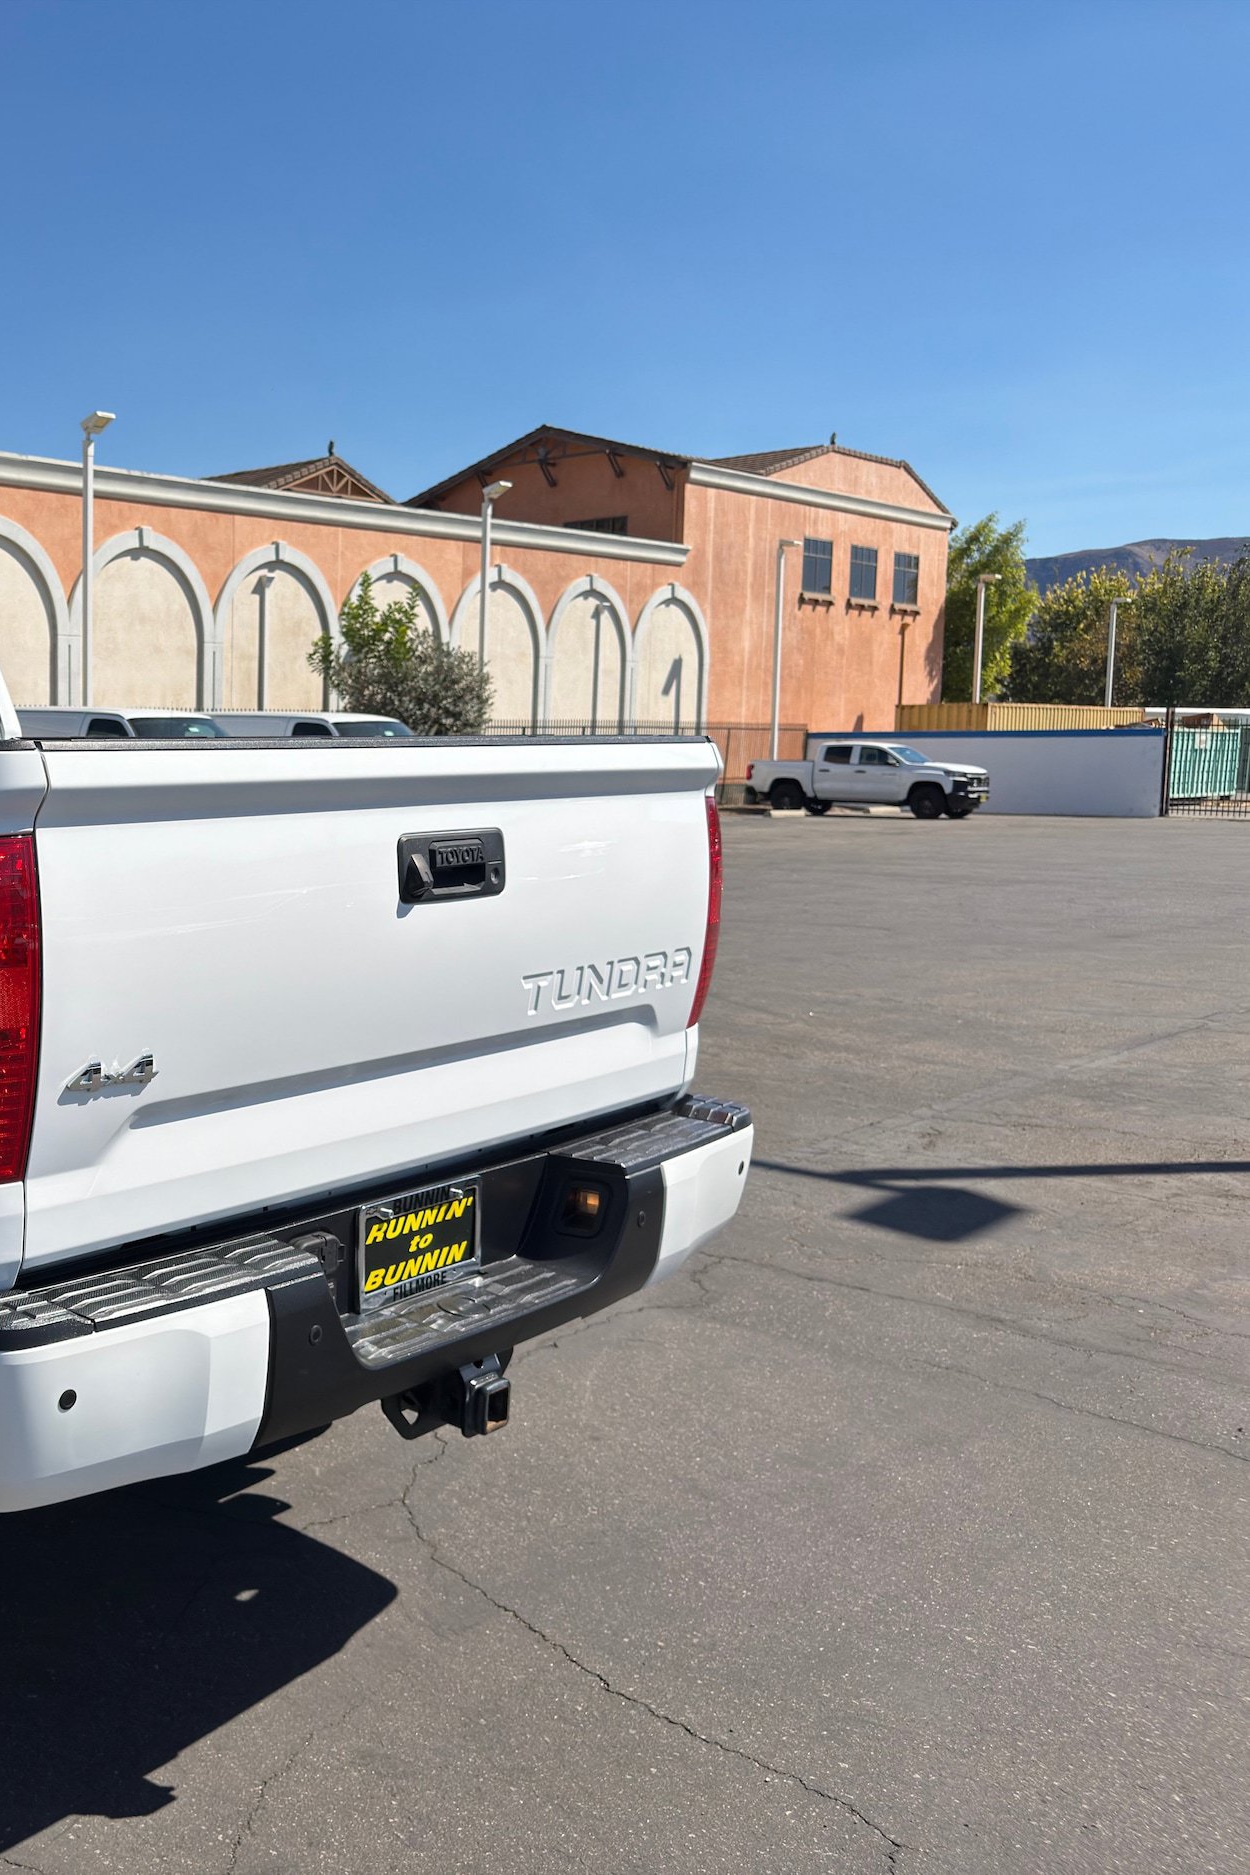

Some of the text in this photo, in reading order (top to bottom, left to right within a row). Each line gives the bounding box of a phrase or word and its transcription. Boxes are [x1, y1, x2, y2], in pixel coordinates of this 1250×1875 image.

[438, 847, 484, 865] TOYOTA
[521, 946, 692, 1016] TUNDRA
[365, 1197, 473, 1245] RUNNIN'
[408, 1233, 433, 1252] to
[364, 1241, 467, 1293] BUNNIN
[393, 1271, 447, 1301] FILLMORE
